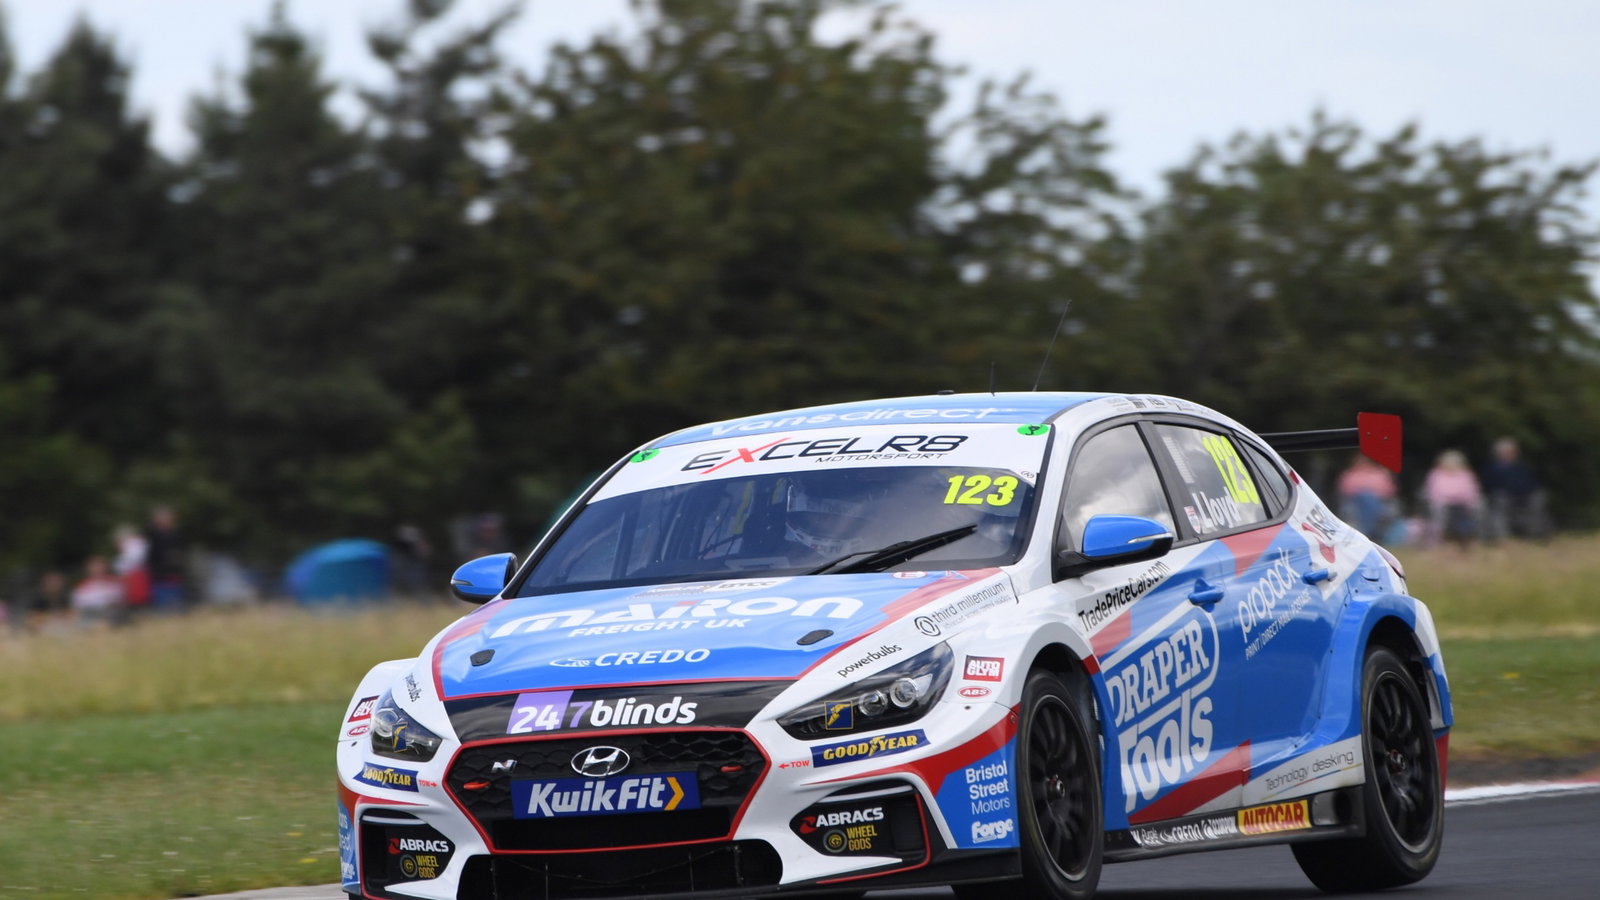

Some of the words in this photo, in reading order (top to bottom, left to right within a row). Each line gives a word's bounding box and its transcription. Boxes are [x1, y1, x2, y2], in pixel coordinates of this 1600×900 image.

[711, 407, 1007, 436] vansdirect
[680, 435, 969, 474] EXCELR8
[815, 452, 949, 464] MOTORSPORT
[1202, 435, 1259, 504] 123
[943, 475, 1018, 506] 123
[1192, 487, 1242, 529] Lloyd
[931, 603, 958, 624] third
[957, 582, 1006, 612] millennium
[1078, 560, 1171, 632] TradePriceCars.com
[1238, 547, 1301, 643] propack
[568, 620, 699, 637] FREIGHT
[705, 618, 752, 628] UK
[595, 648, 711, 667] CREDO
[837, 643, 902, 678] powerbulbs
[1106, 619, 1209, 727] DRAPER
[1118, 688, 1213, 813] Tools
[791, 760, 810, 768] TOW
[966, 761, 1008, 784] Bristol
[1265, 765, 1310, 791] Technology
[1312, 750, 1355, 774] desking
[969, 778, 1009, 800] Street
[816, 807, 884, 828] ABRACS
[972, 796, 1010, 815] Motors
[1243, 802, 1307, 833] AUTOCAR
[847, 825, 878, 838] WHEEL
[848, 838, 872, 851] GODS
[400, 838, 449, 853] ABRACS
[416, 855, 439, 868] WHEEL
[418, 867, 436, 878] GODS
